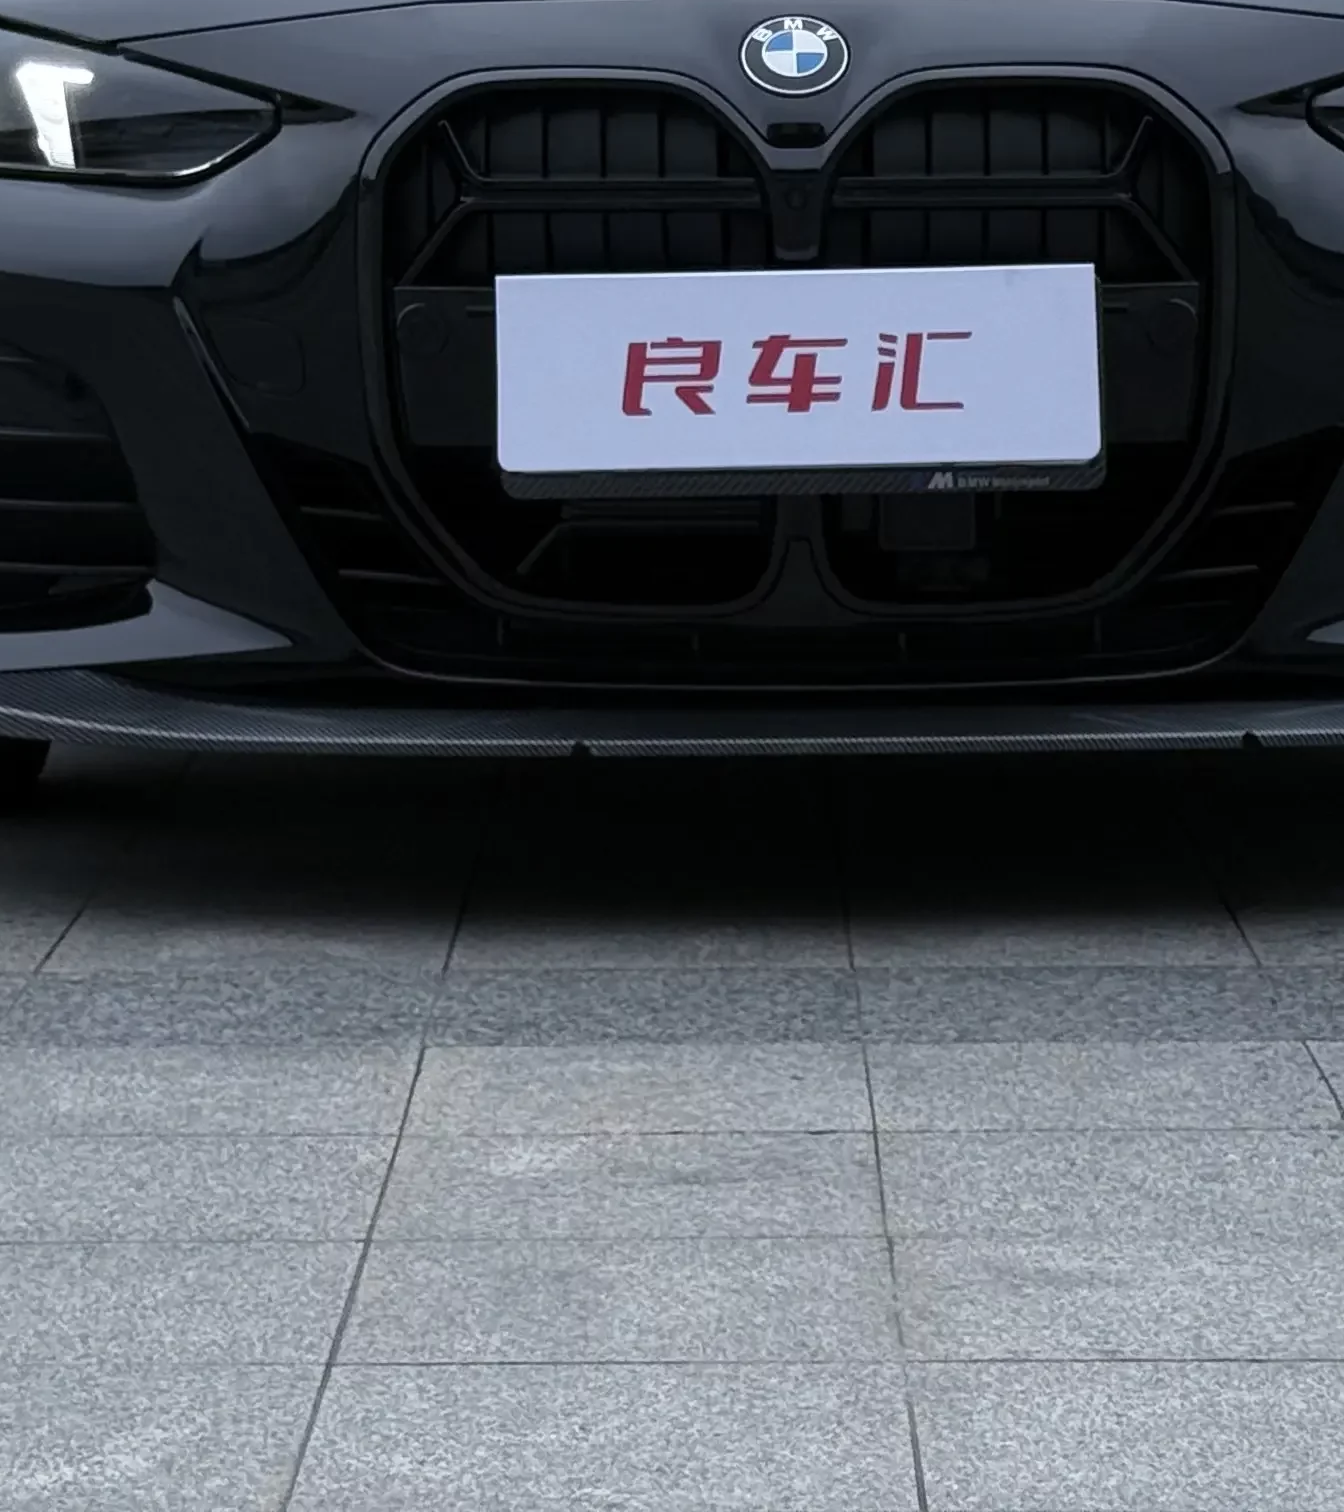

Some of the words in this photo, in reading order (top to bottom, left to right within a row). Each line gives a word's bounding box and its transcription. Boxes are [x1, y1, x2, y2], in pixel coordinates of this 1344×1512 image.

[751, 18, 838, 42] BMW
[621, 331, 972, 416] 良车汇
